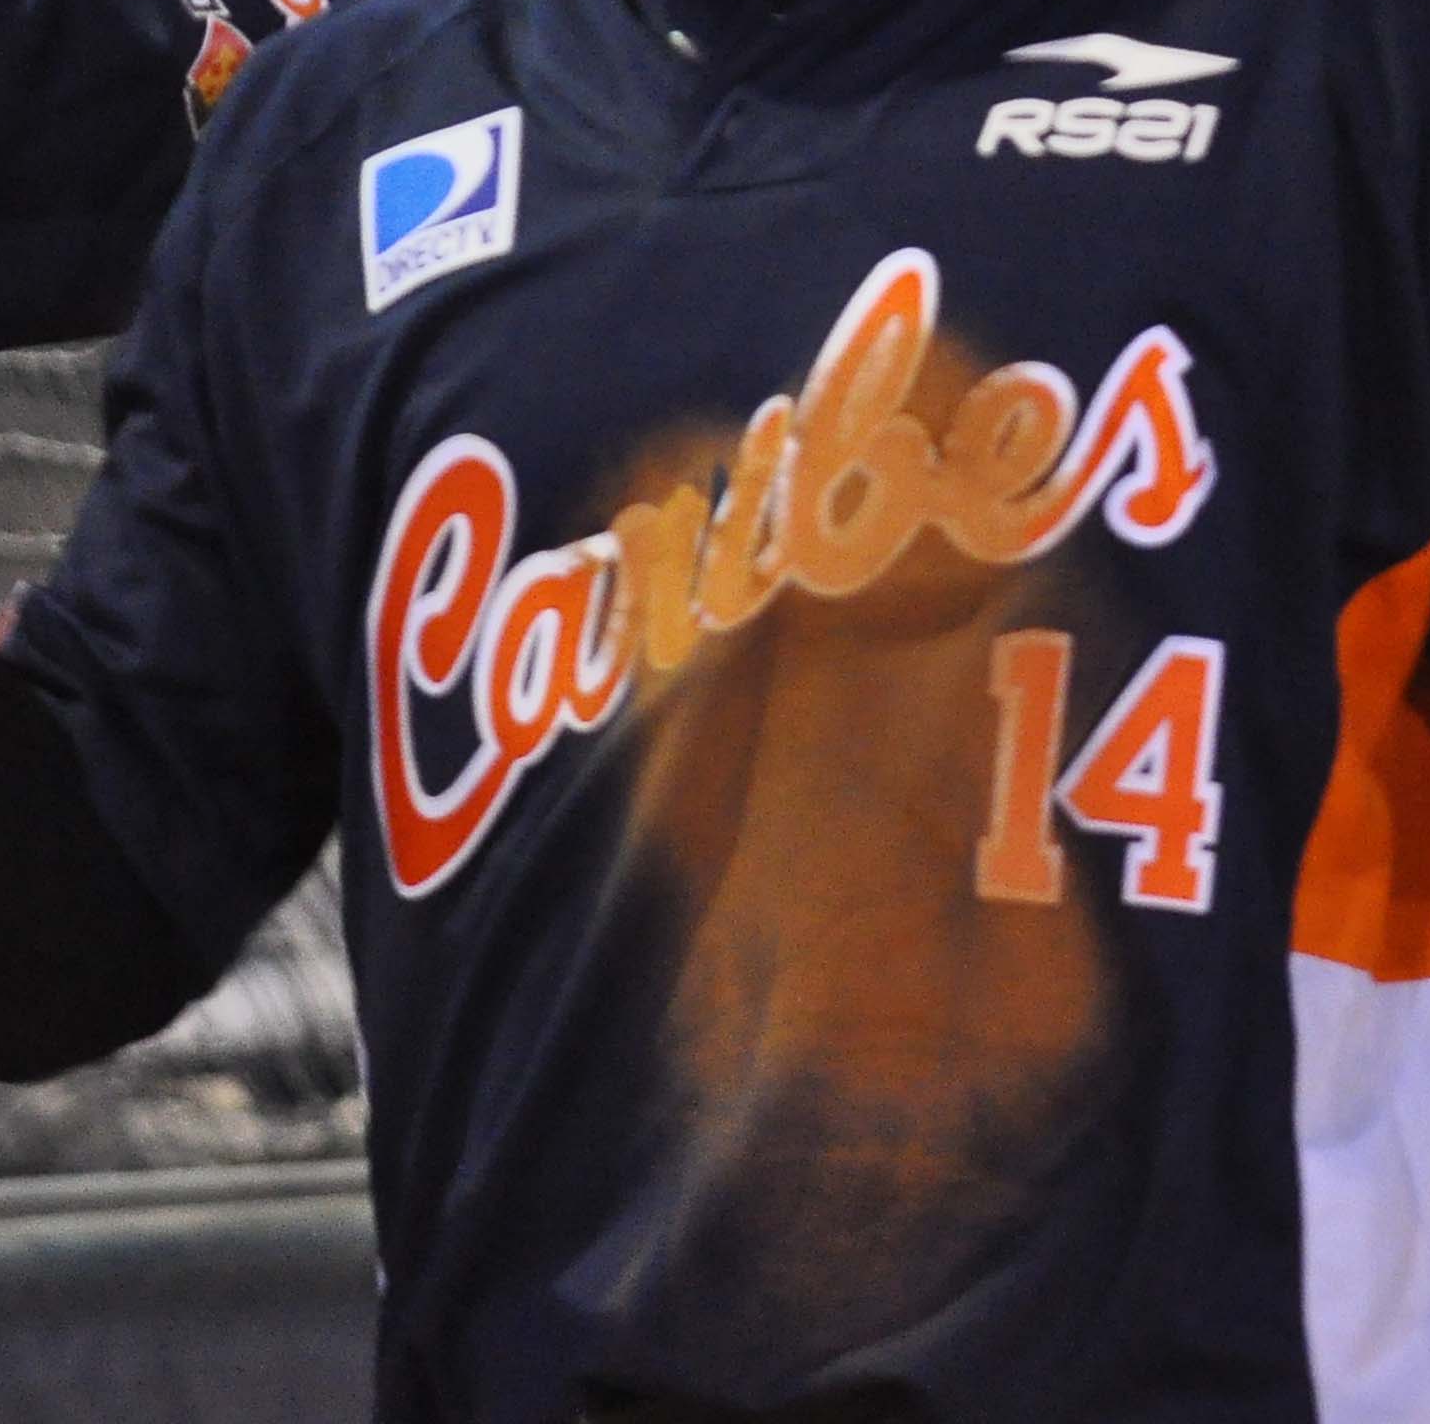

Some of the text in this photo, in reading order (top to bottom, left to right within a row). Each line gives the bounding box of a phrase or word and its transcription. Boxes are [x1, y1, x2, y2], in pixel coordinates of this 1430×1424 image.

[976, 95, 1219, 163] RS21
[368, 247, 1216, 898] Caribes
[976, 627, 1224, 913] 14
